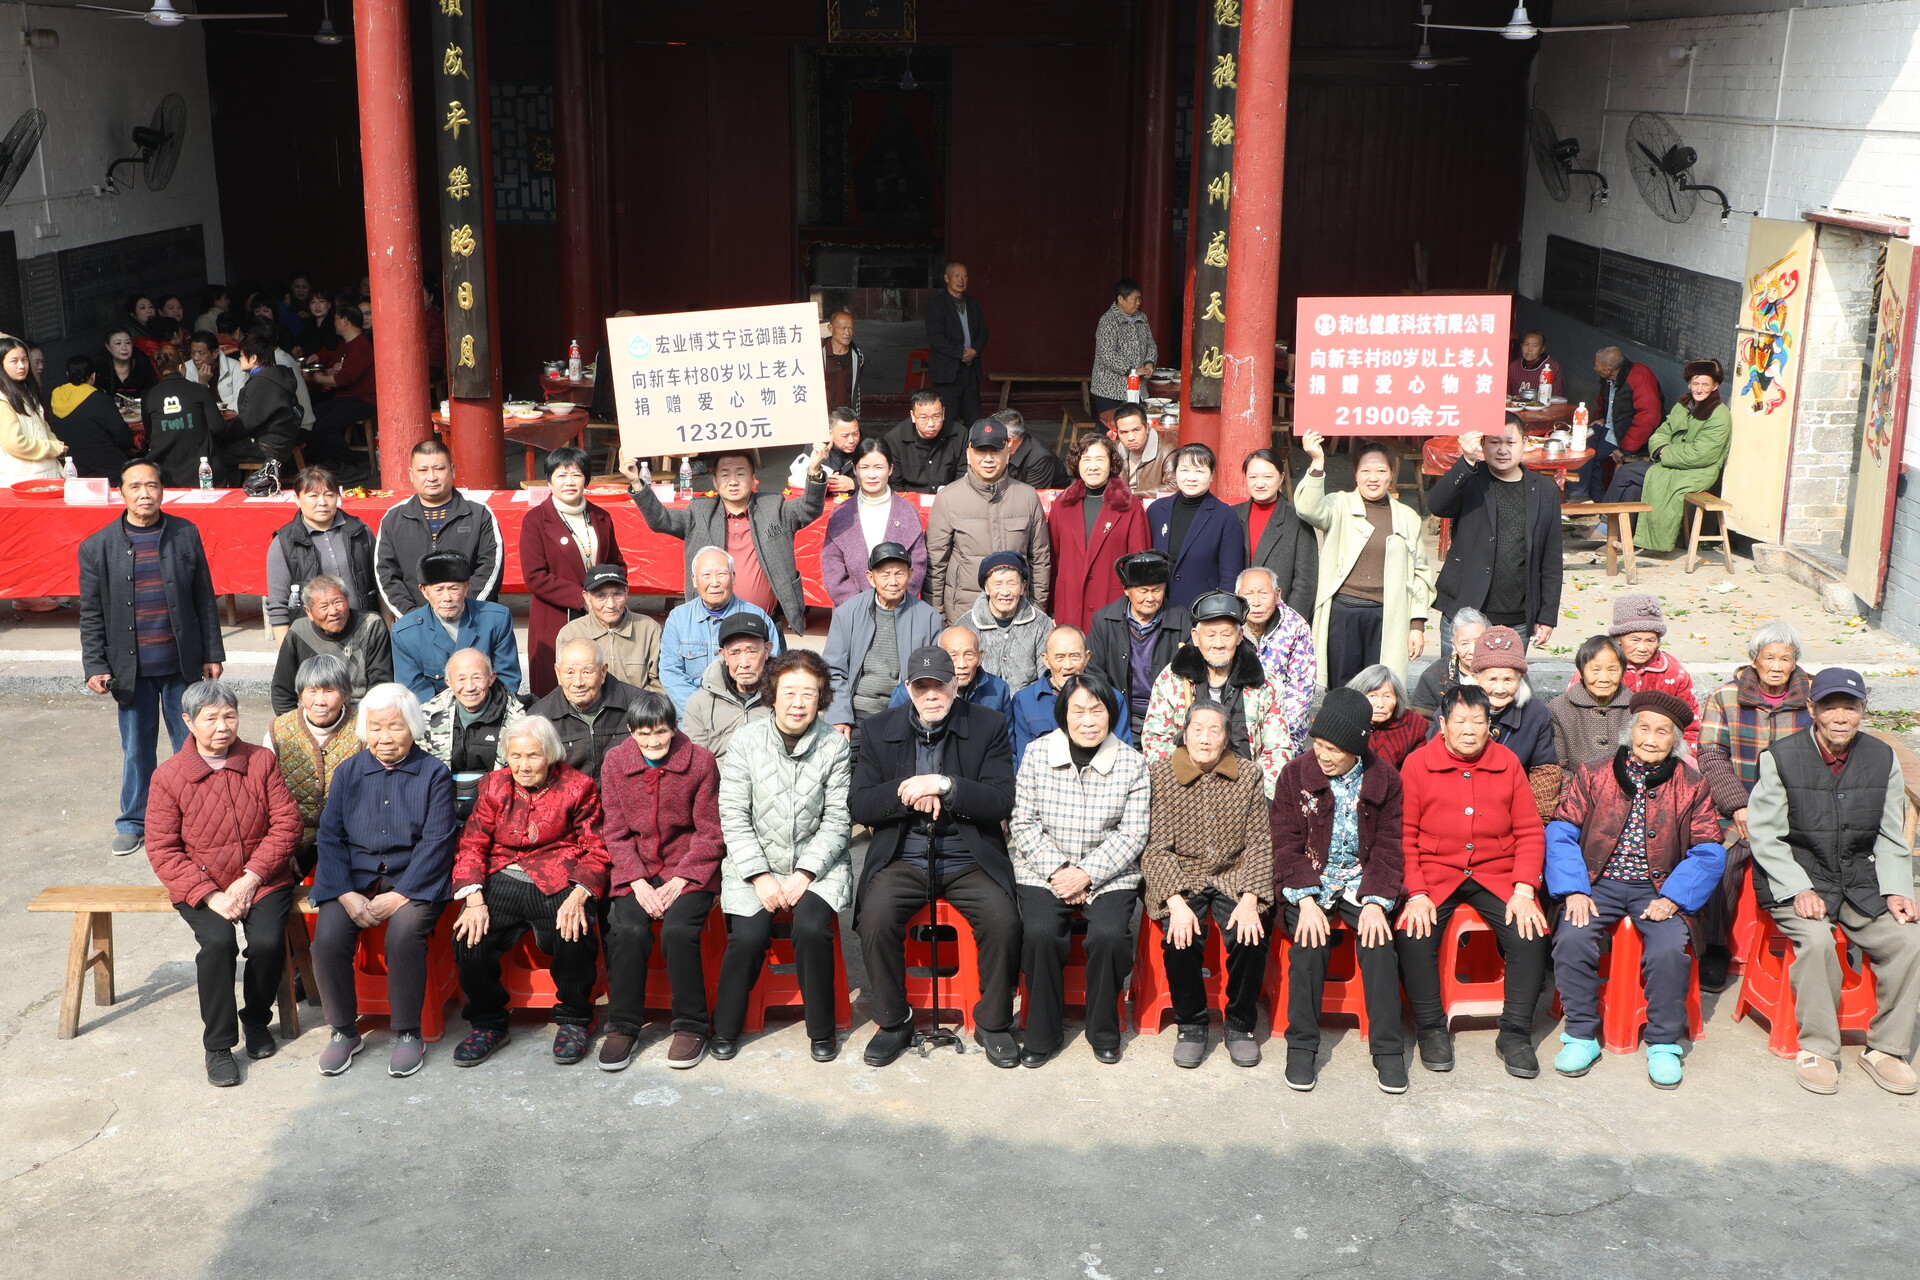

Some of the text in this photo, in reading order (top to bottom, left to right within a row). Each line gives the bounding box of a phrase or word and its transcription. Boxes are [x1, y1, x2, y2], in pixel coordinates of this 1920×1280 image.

[1338, 313, 1495, 335] 和也健康科技有限公司
[656, 324, 803, 354] 宏业博艾宁远御膳方
[1310, 347, 1493, 369] 向新车村80岁以上老人
[632, 358, 805, 390] 向新车村80岁以上老人
[1335, 404, 1460, 427] 21900余元
[676, 417, 773, 443] 12320元
